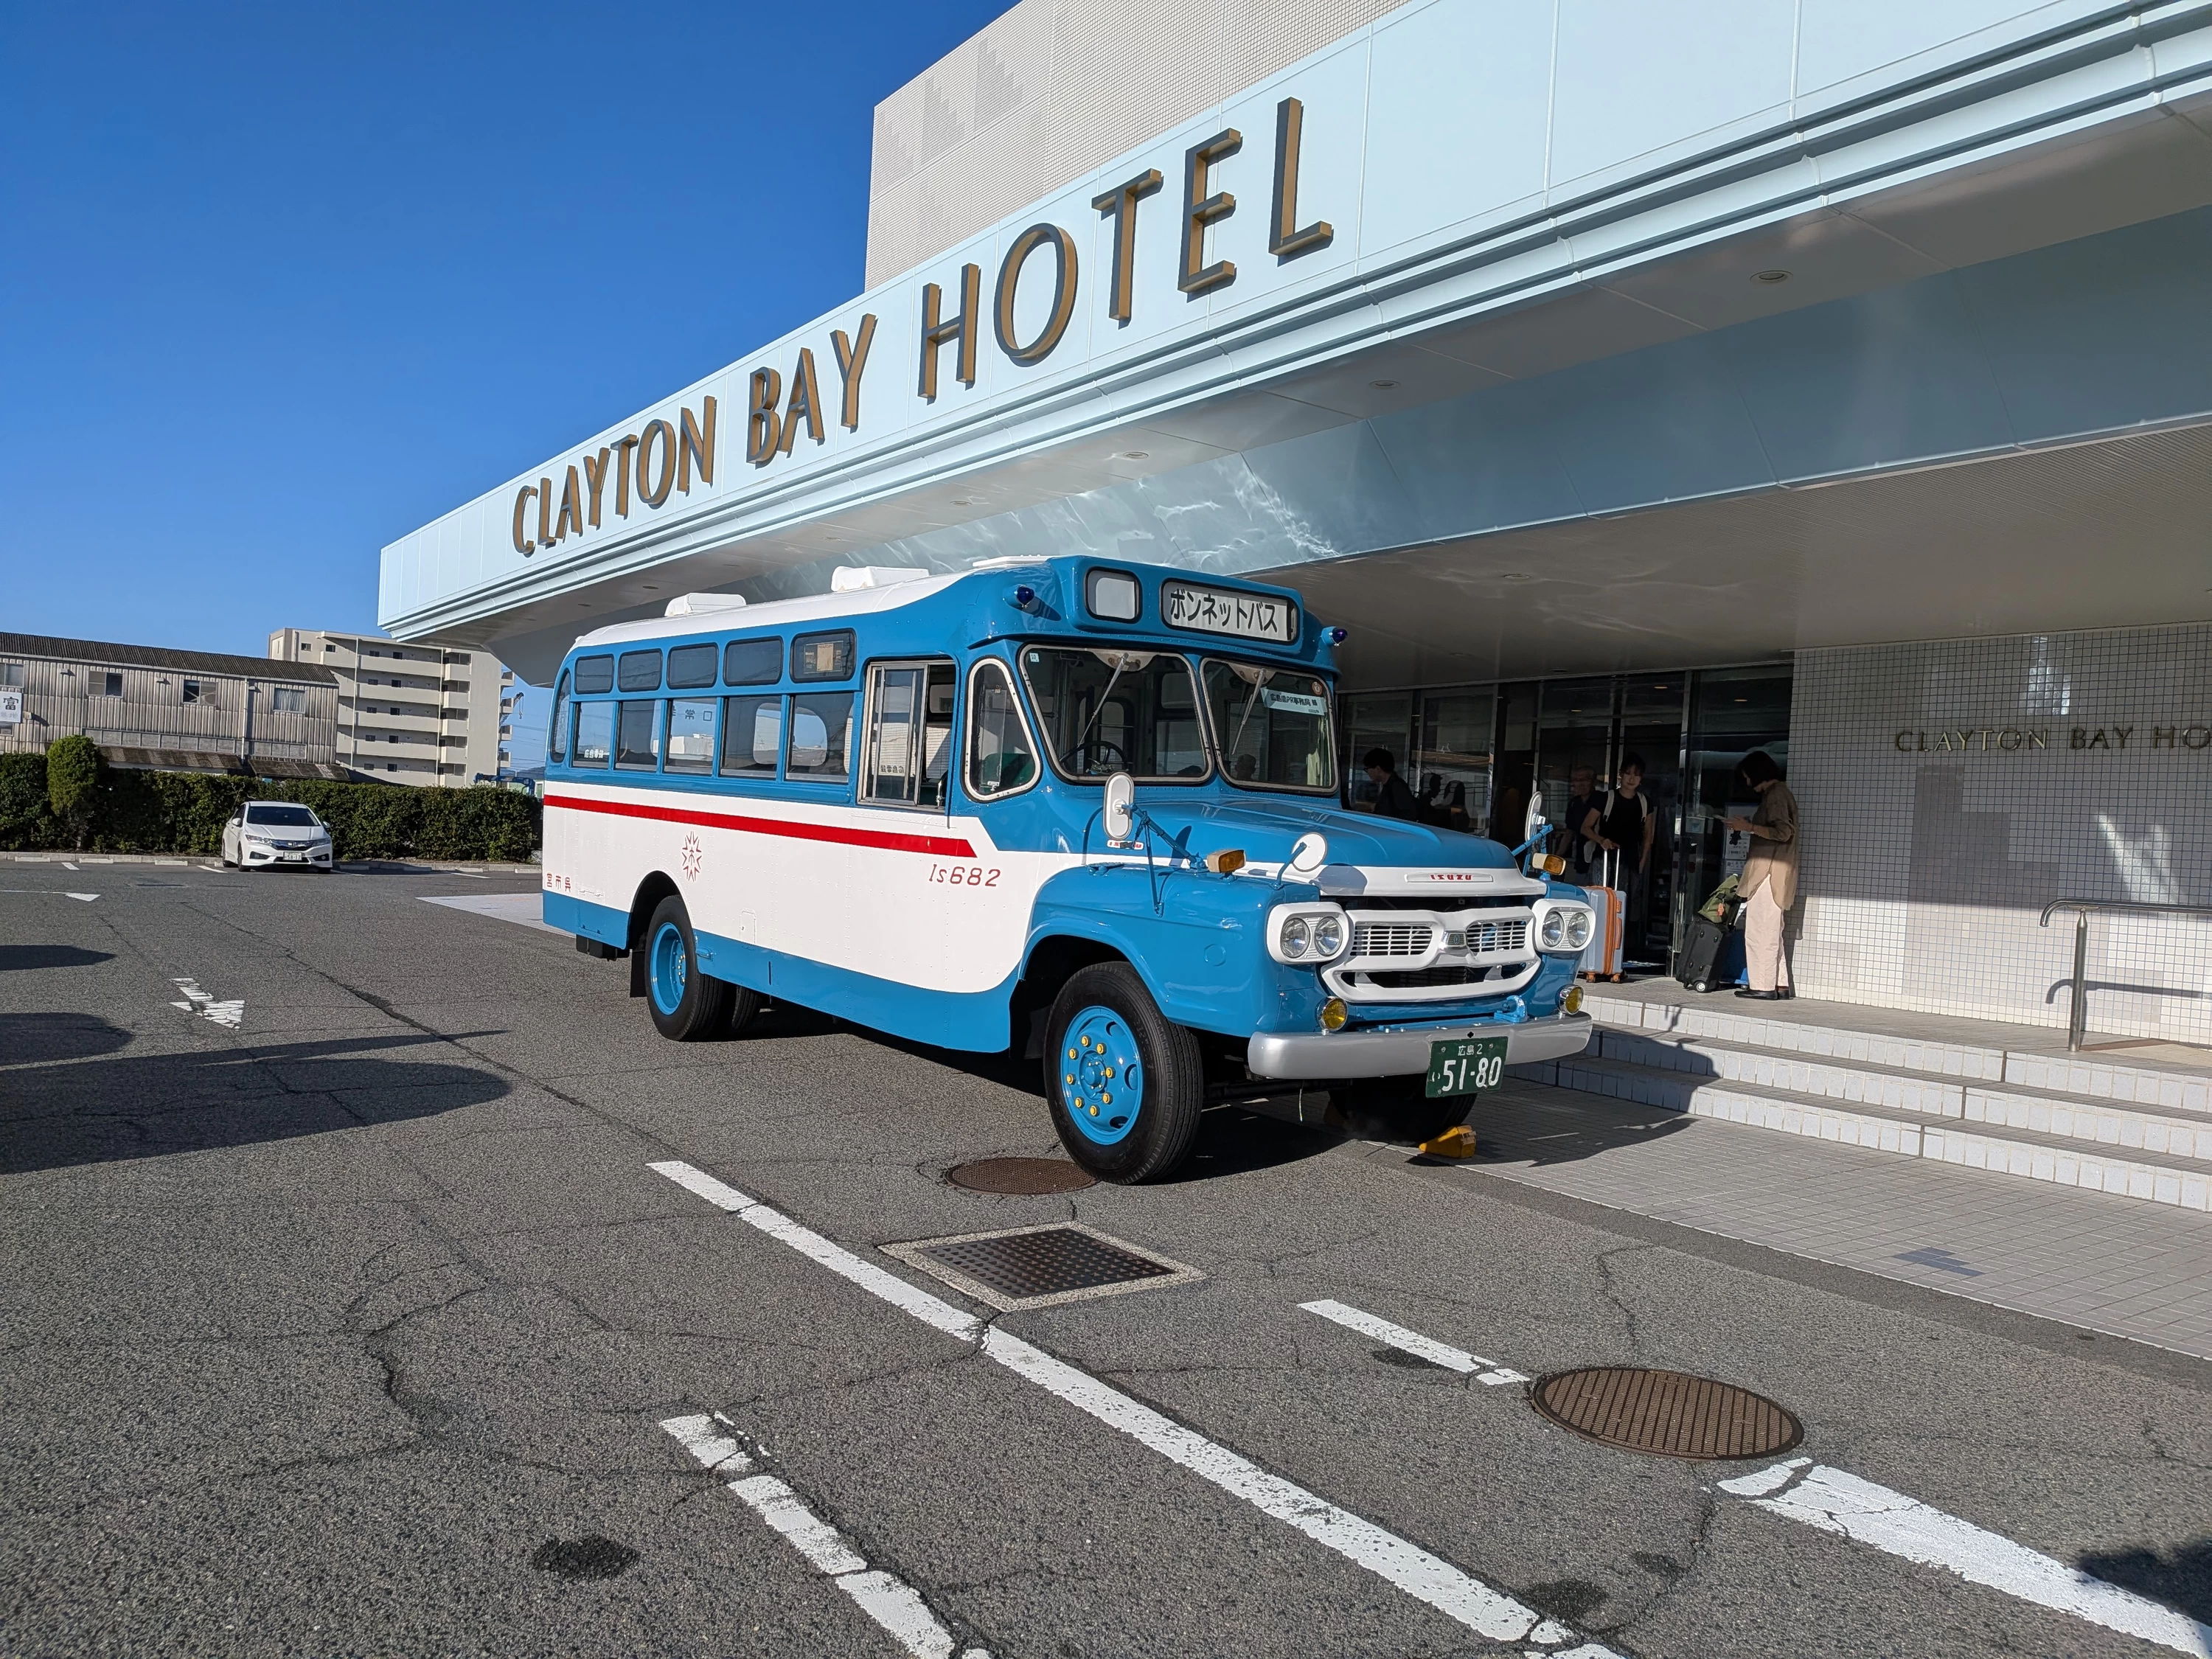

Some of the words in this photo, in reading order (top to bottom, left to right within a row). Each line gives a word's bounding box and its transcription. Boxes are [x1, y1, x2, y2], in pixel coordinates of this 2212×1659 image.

[512, 395, 718, 558] CLAYTON
[745, 313, 877, 467] BAY
[917, 97, 1334, 402] HOTEL
[1170, 588, 1278, 633] ボンネットバス
[1895, 728, 2049, 752] CLAYTON
[2070, 726, 2134, 750] BAY
[1458, 1045, 1474, 1056] 広島
[1476, 1043, 1483, 1055] 2
[1441, 1056, 1502, 1092] 51-80
